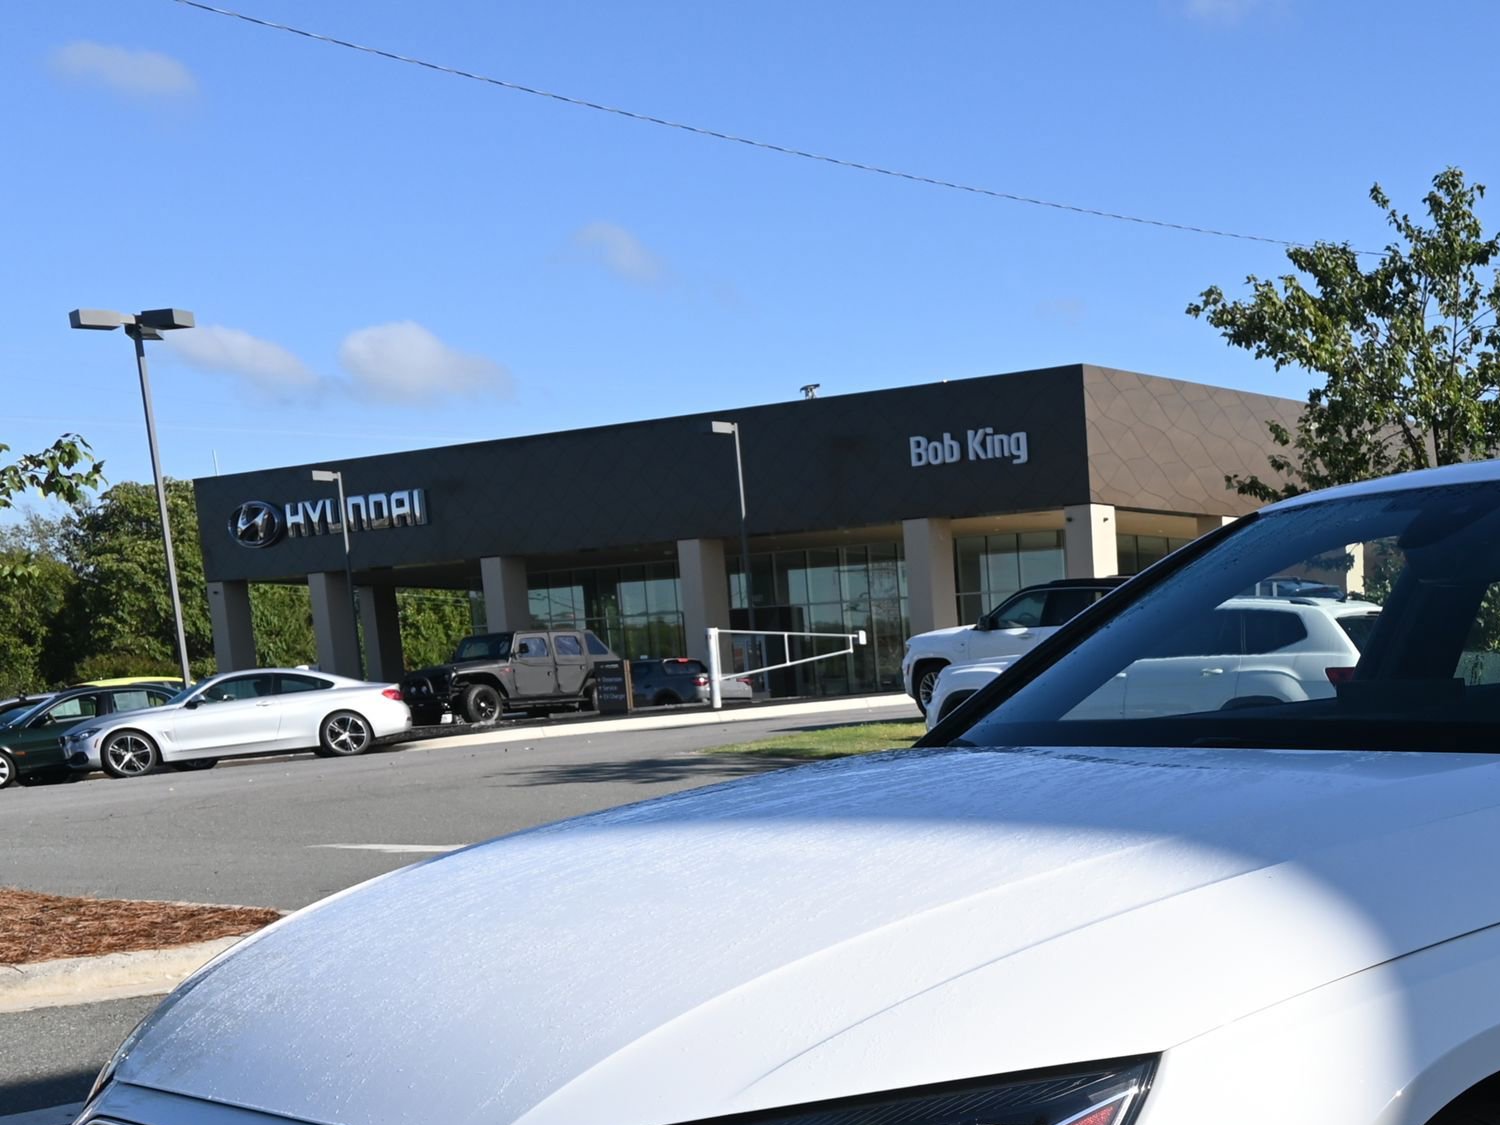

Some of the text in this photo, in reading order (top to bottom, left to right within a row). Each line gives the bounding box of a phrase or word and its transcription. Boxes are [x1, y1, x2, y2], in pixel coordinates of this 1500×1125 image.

[909, 427, 1028, 467] Bob King
[285, 488, 428, 537] HYUNDAI
